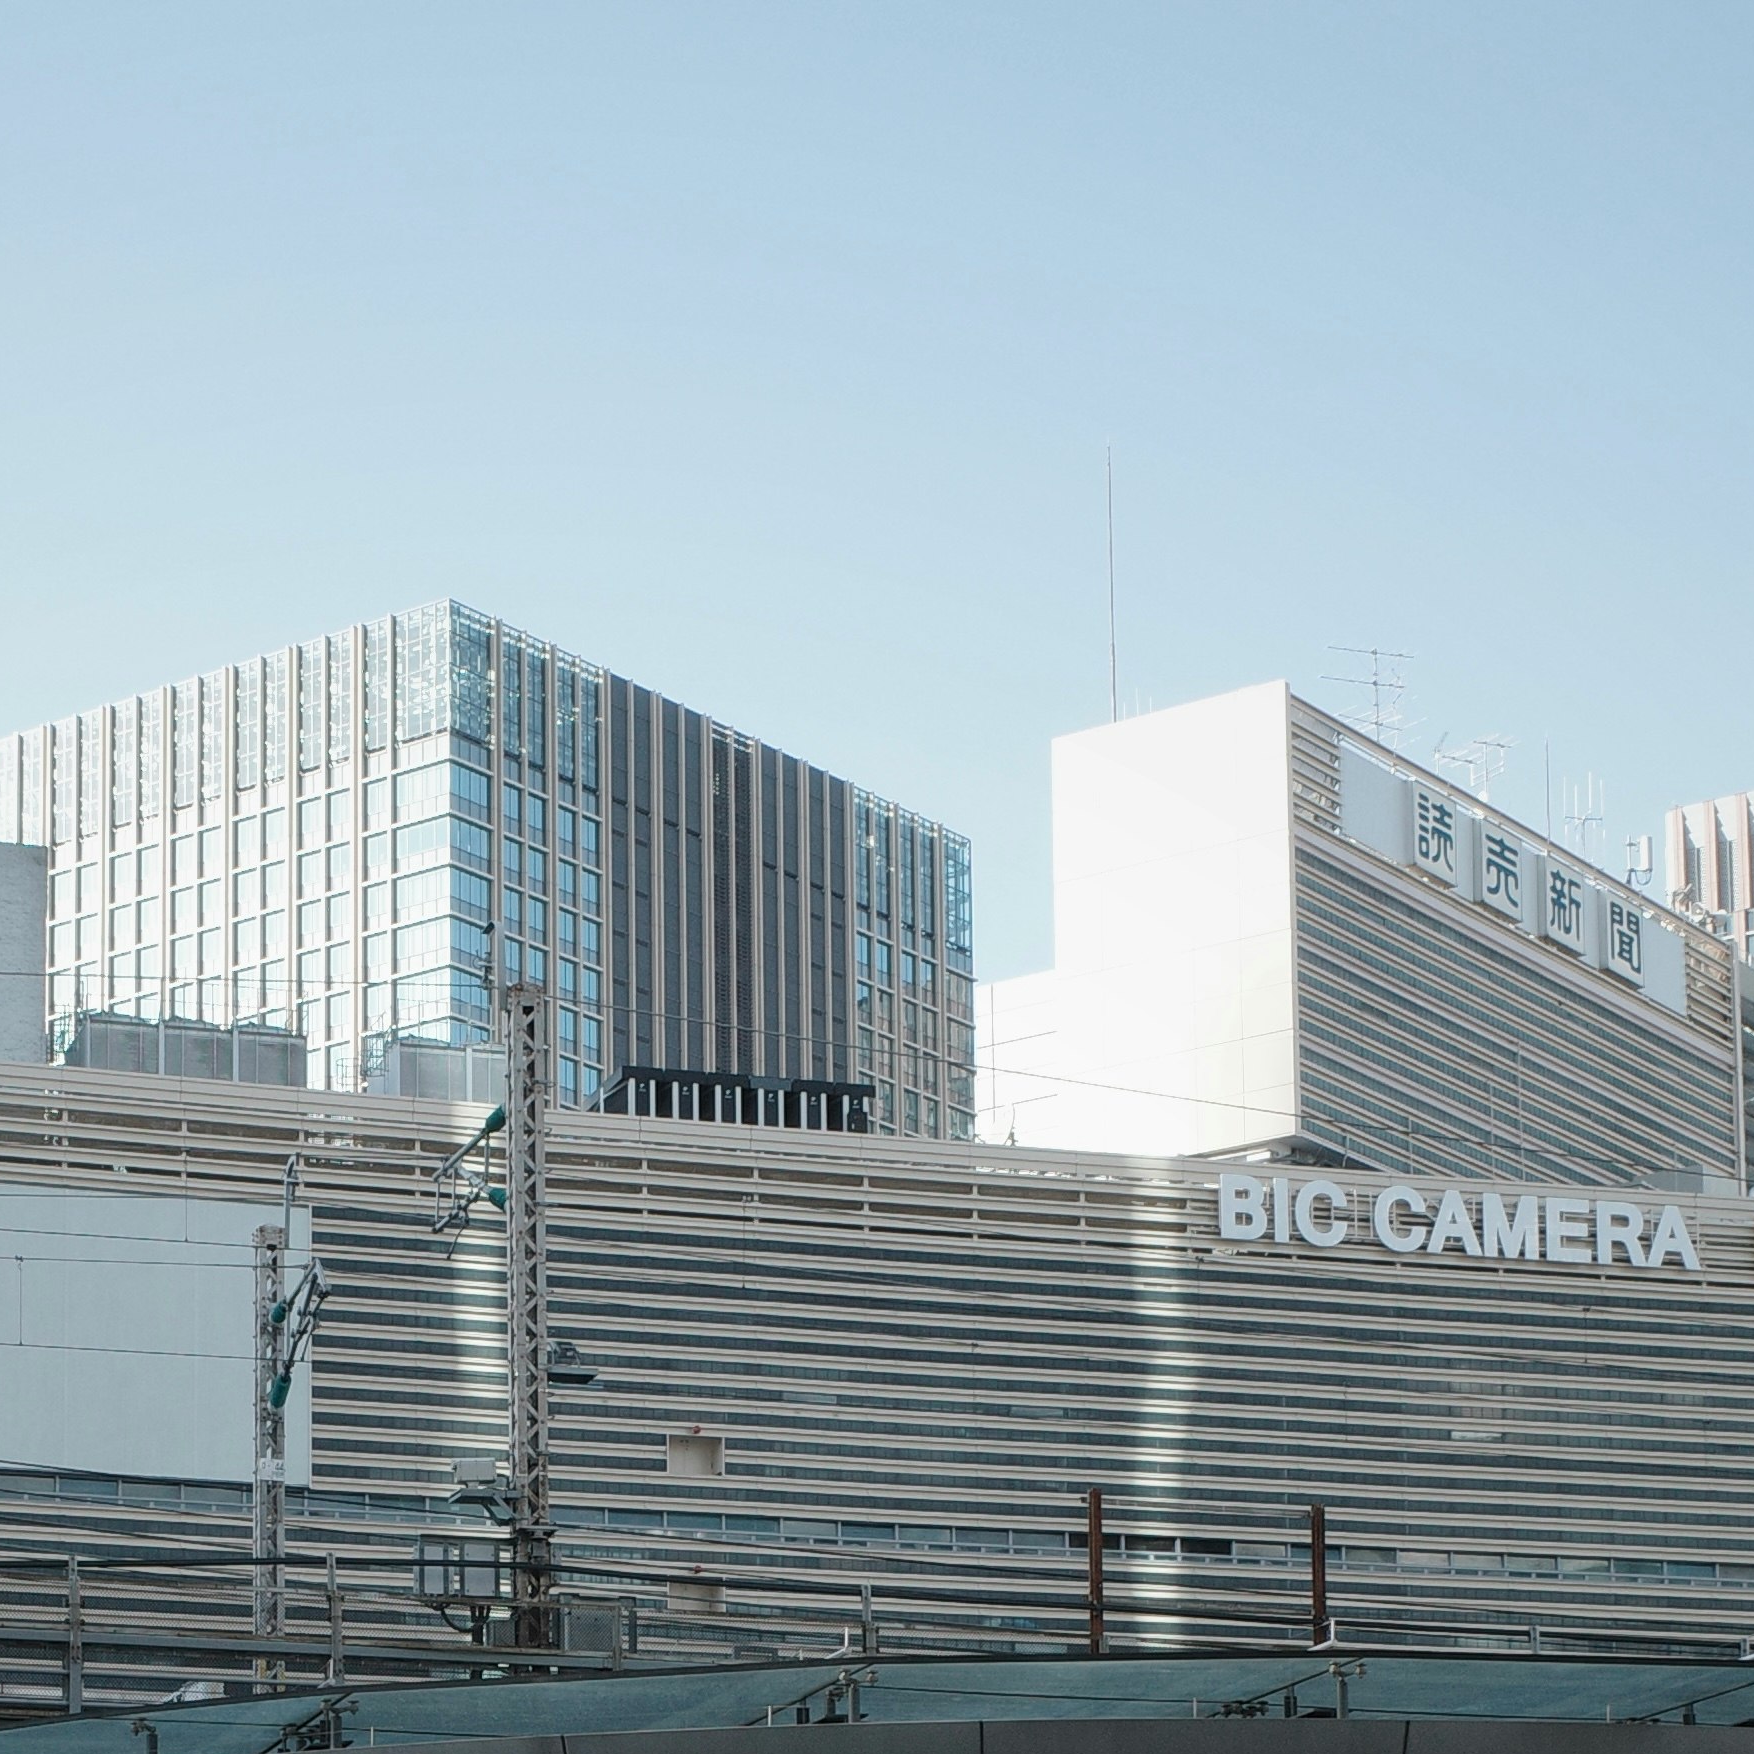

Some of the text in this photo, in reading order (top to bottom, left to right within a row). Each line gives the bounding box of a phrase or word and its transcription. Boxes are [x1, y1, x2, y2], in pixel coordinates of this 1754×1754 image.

[1417, 791, 1643, 974] 読売新聞
[1218, 1172, 1703, 1272] BIC CAMERA
